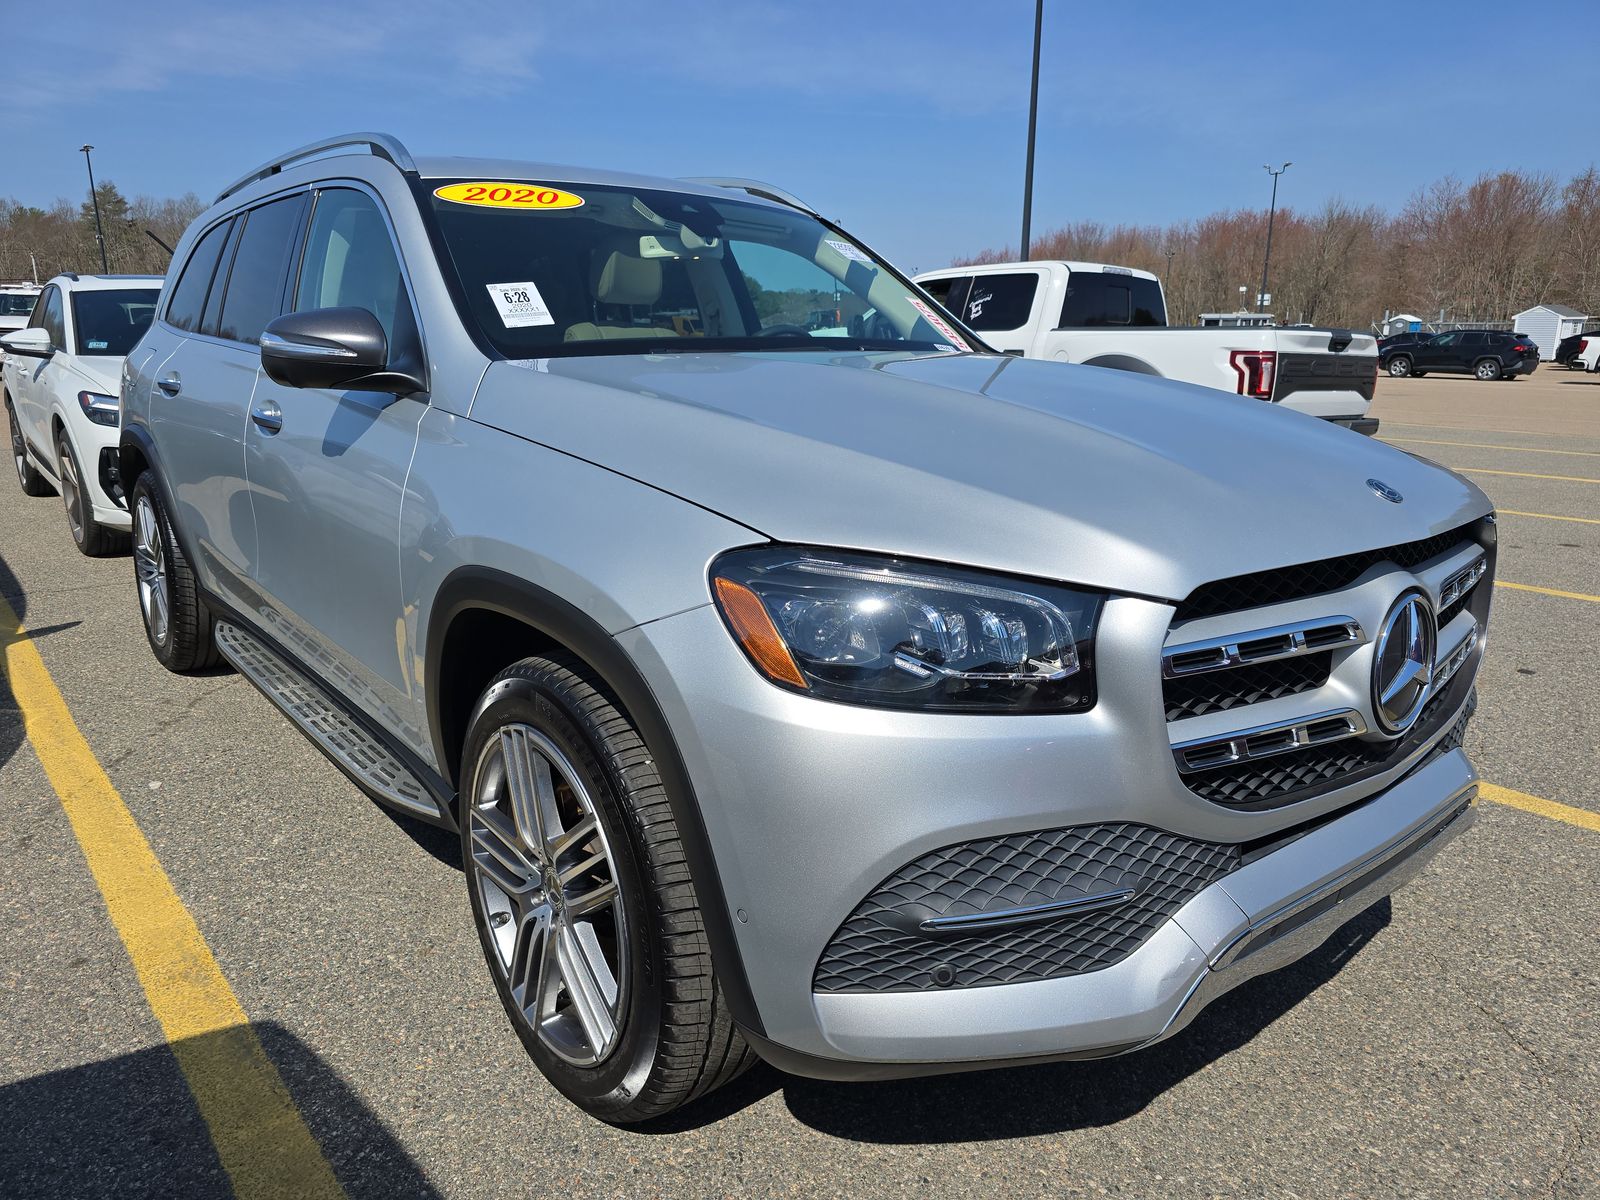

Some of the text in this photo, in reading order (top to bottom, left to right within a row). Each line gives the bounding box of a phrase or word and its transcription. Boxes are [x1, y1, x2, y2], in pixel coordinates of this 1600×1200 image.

[462, 186, 559, 205] 2020
[503, 291, 531, 304] 6:28
[1281, 358, 1375, 377] FORD
